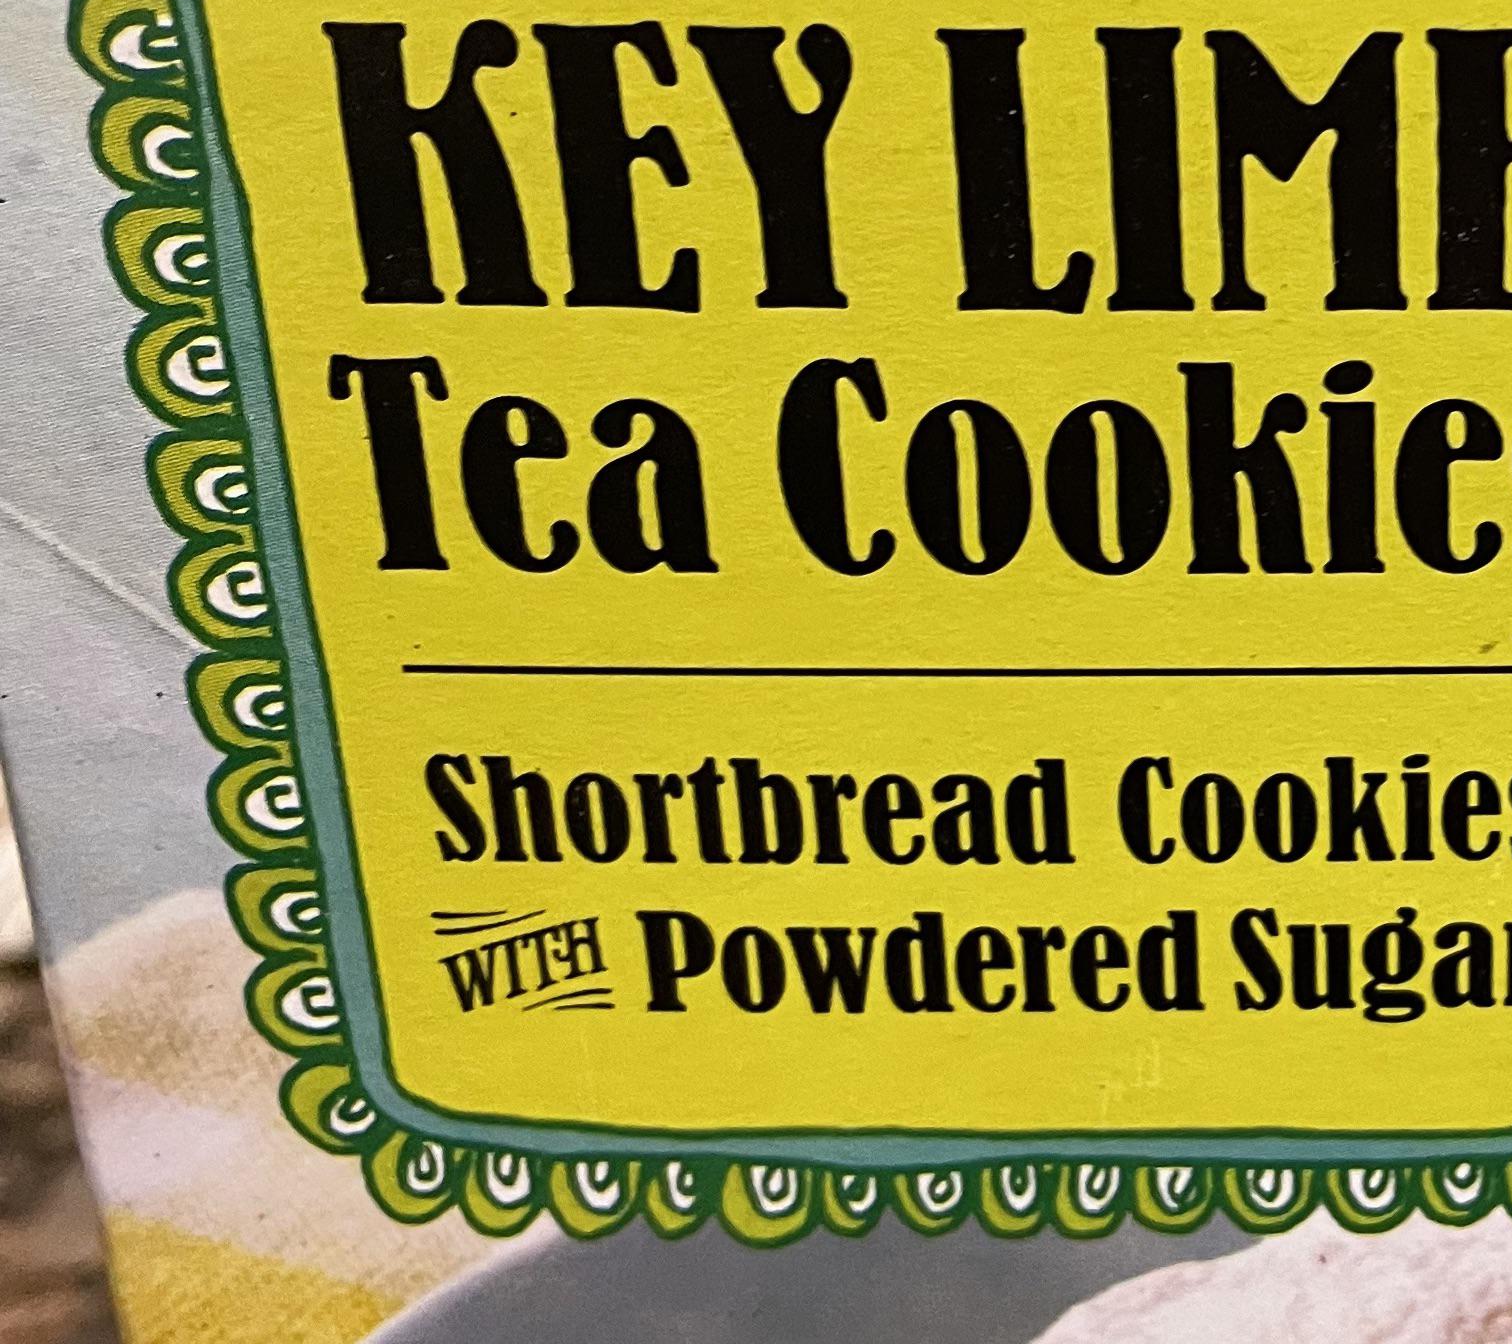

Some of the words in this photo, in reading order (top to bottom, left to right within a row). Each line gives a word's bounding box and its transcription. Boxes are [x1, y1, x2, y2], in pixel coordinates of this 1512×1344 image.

[322, 19, 852, 313] KEY
[329, 355, 719, 573] Tea
[425, 754, 1075, 865] Shortbread
[437, 916, 608, 1011] WITH
[636, 911, 1204, 1013] Powdered
